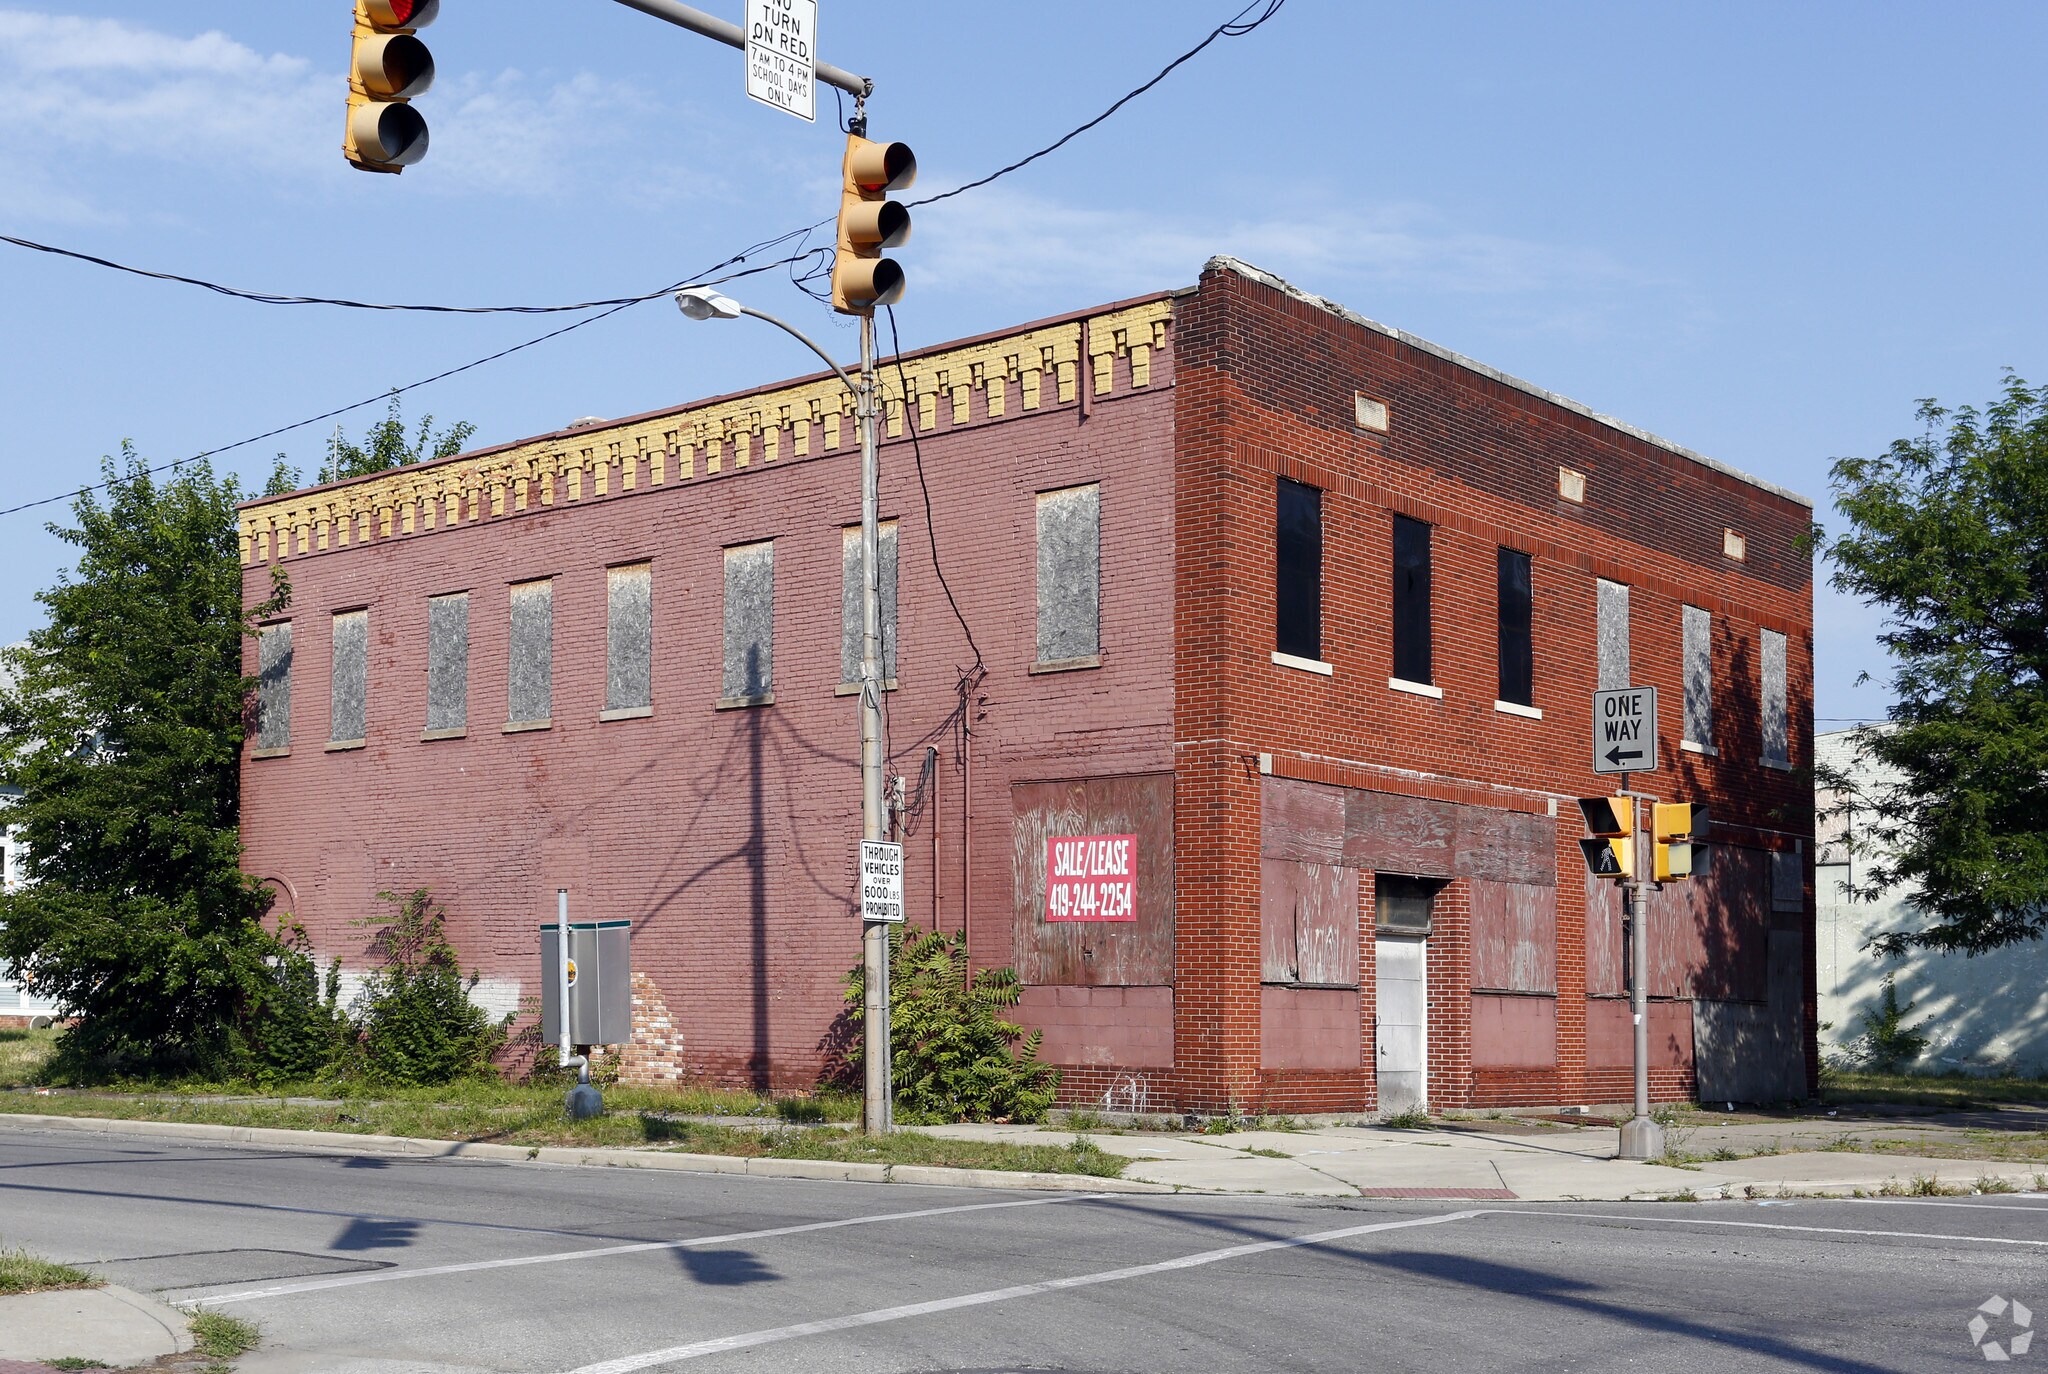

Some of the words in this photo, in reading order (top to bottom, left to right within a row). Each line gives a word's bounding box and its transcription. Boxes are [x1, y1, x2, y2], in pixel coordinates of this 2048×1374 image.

[763, 5, 800, 35] TURN
[754, 23, 773, 44] ON
[780, 33, 807, 58] RED
[752, 46, 757, 60] 7
[759, 52, 770, 65] AM
[774, 56, 785, 72] TO
[788, 63, 794, 76] 4
[797, 68, 808, 82] PM
[752, 63, 783, 88] SCHOOL
[788, 78, 807, 97] DAYS
[768, 86, 792, 107] ONLY
[1605, 695, 1642, 717] ONE
[1604, 719, 1641, 741] WAY
[864, 846, 898, 861] THROUGH
[1054, 840, 1129, 878] SALE/LEASE
[864, 862, 899, 875] VEHICLES
[865, 885, 888, 898] 6000
[889, 891, 899, 899] LBS
[1050, 883, 1131, 916] 419-244-2254
[866, 902, 899, 916] PROHIBITED
